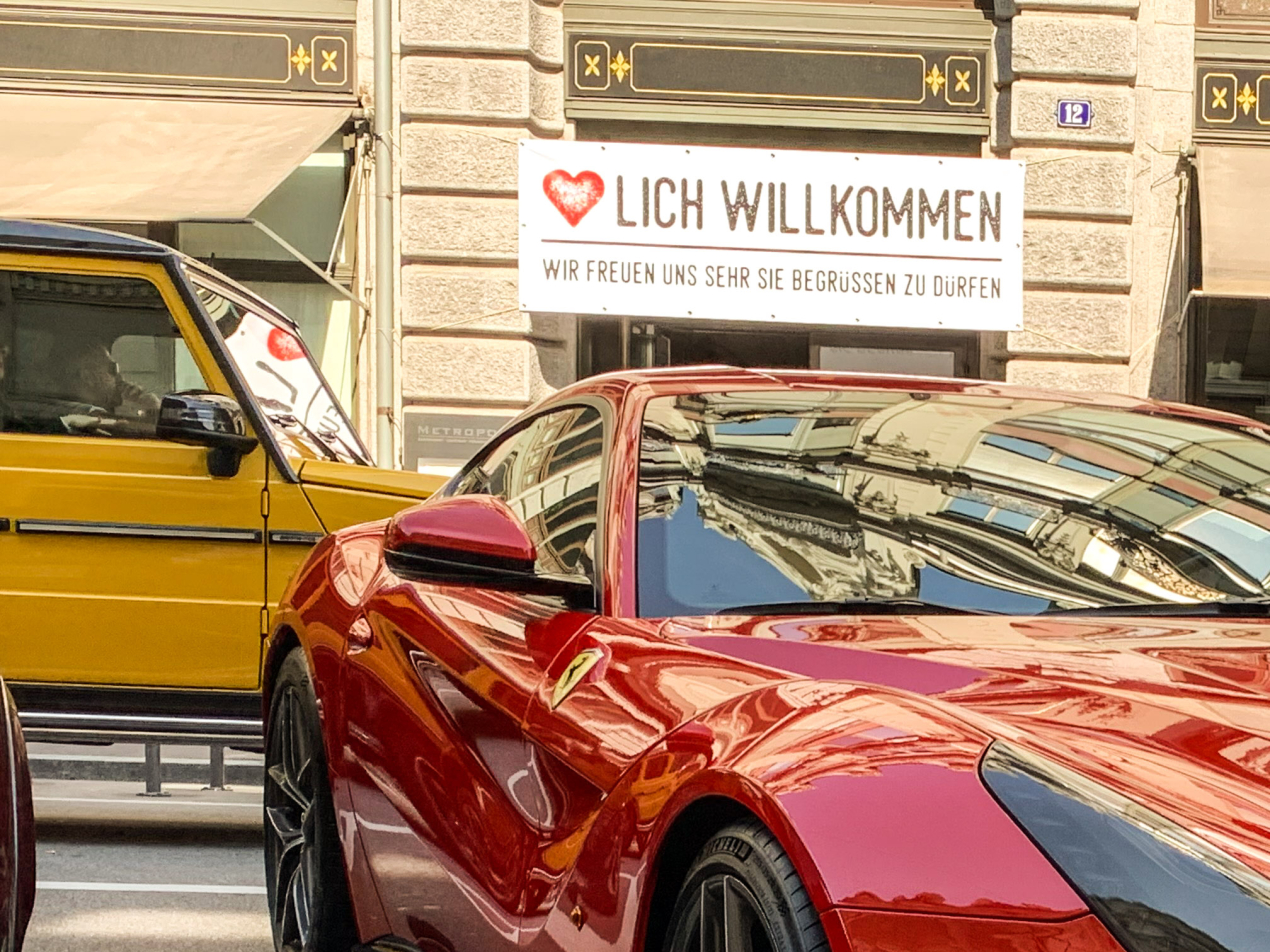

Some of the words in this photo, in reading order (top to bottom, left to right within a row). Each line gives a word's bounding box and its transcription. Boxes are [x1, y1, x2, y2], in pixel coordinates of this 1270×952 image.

[1064, 103, 1084, 124] 12
[617, 175, 703, 230] LICH
[721, 180, 1001, 242] WILLKOMMEN
[543, 259, 579, 281] WIR
[587, 261, 655, 285] FREUEN
[663, 263, 697, 287] UNS
[705, 265, 750, 289] SEHR
[758, 267, 784, 291] SIE
[792, 269, 896, 295] BEGRÜSSEN
[904, 274, 925, 297] ZU
[934, 275, 1001, 299] DÜRFEN
